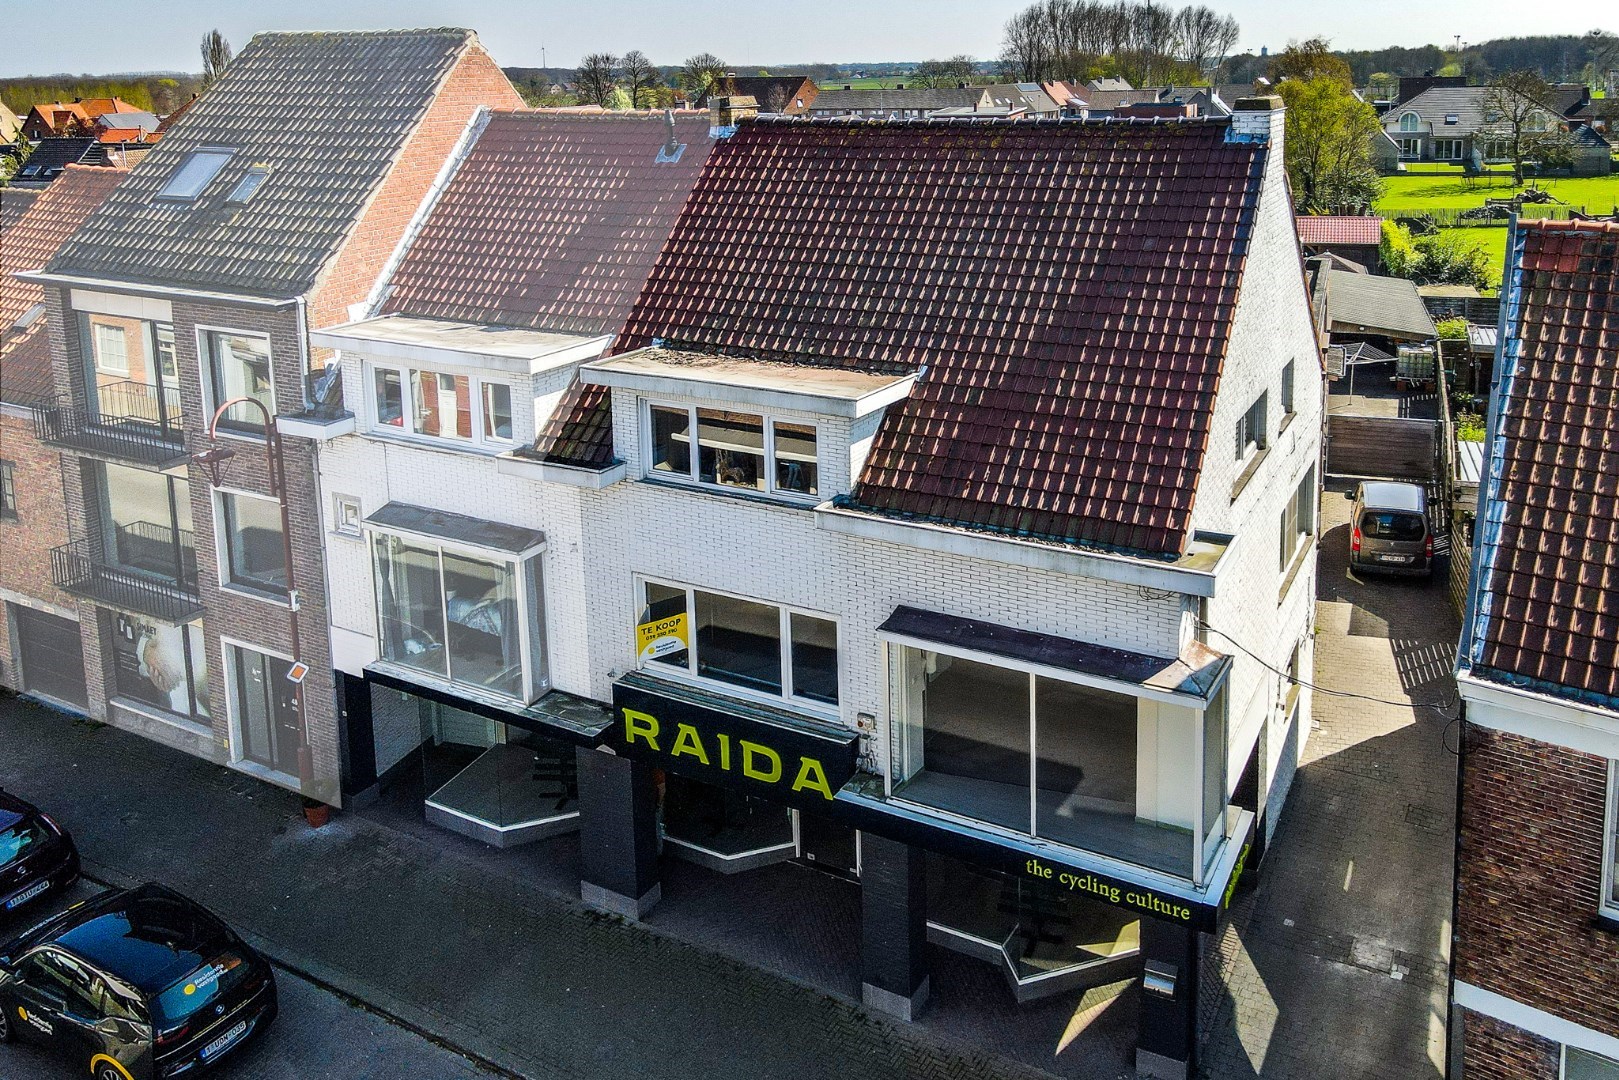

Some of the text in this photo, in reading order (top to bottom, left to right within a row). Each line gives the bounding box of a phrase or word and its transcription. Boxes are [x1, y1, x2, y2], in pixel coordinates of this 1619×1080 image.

[641, 618, 681, 635] TE KOOP
[621, 707, 834, 800] RAIDA
[1025, 859, 1191, 921] the cycling culture
